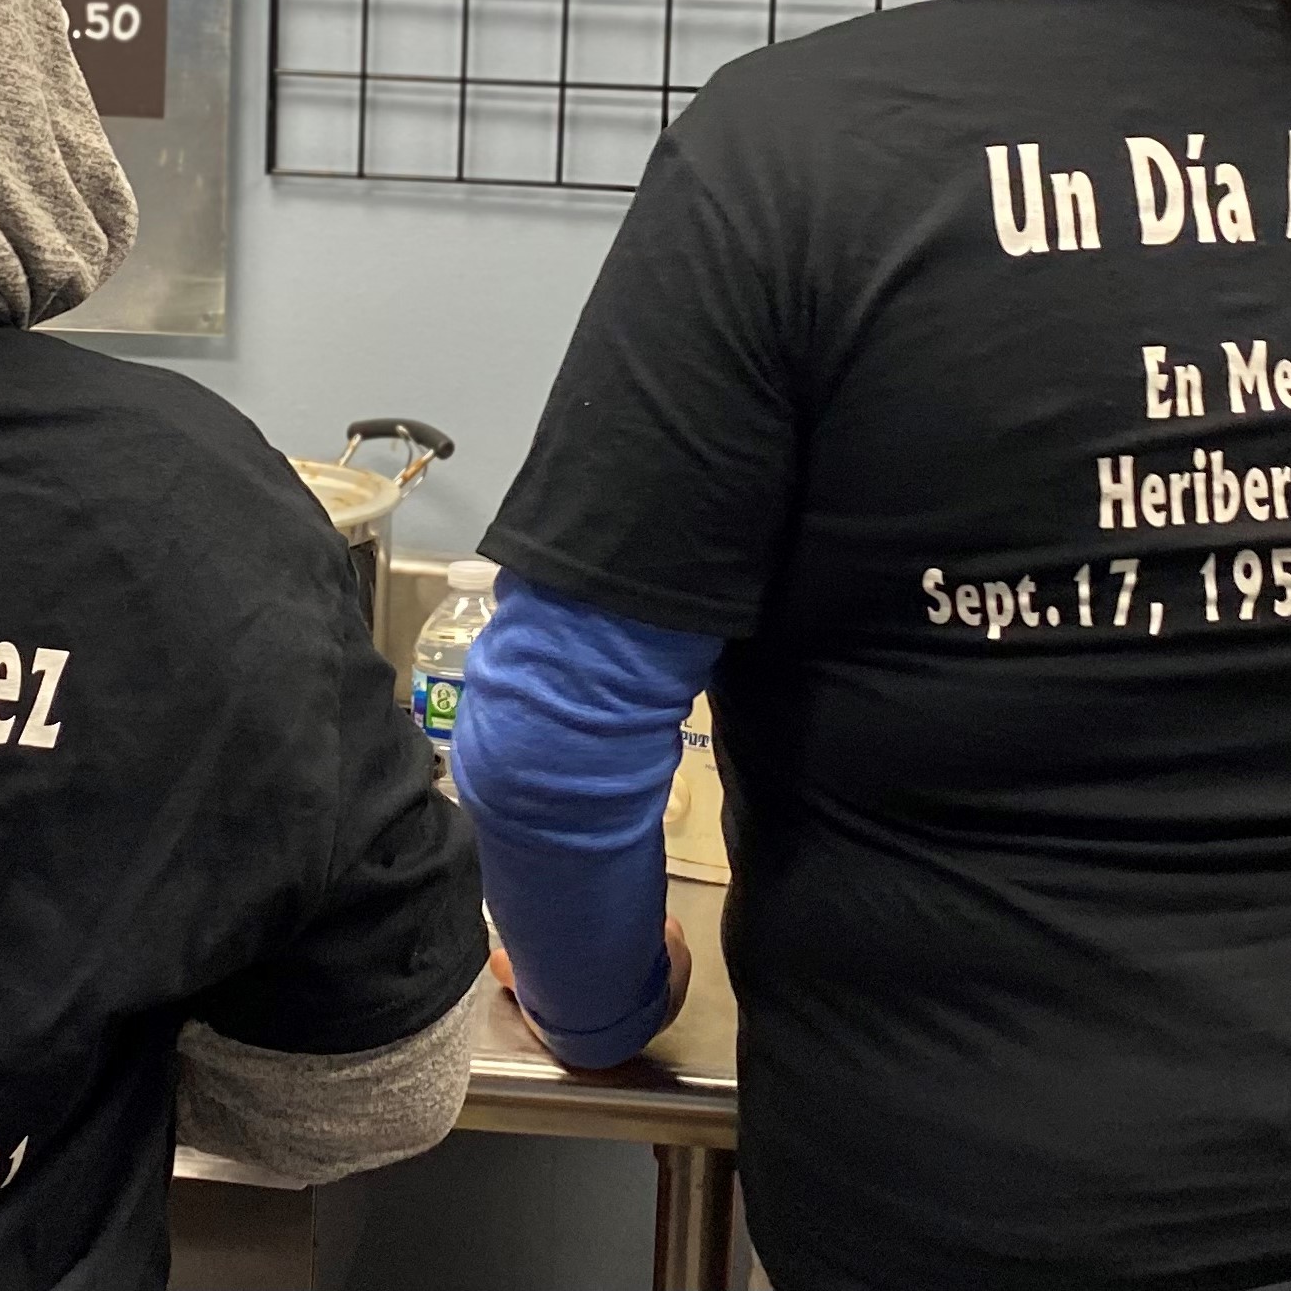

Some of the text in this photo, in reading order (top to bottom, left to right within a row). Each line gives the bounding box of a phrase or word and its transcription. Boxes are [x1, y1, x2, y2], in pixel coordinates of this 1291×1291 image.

[984, 143, 1102, 257] Un
[1124, 133, 1256, 246] Día
[1141, 345, 1205, 419] En
